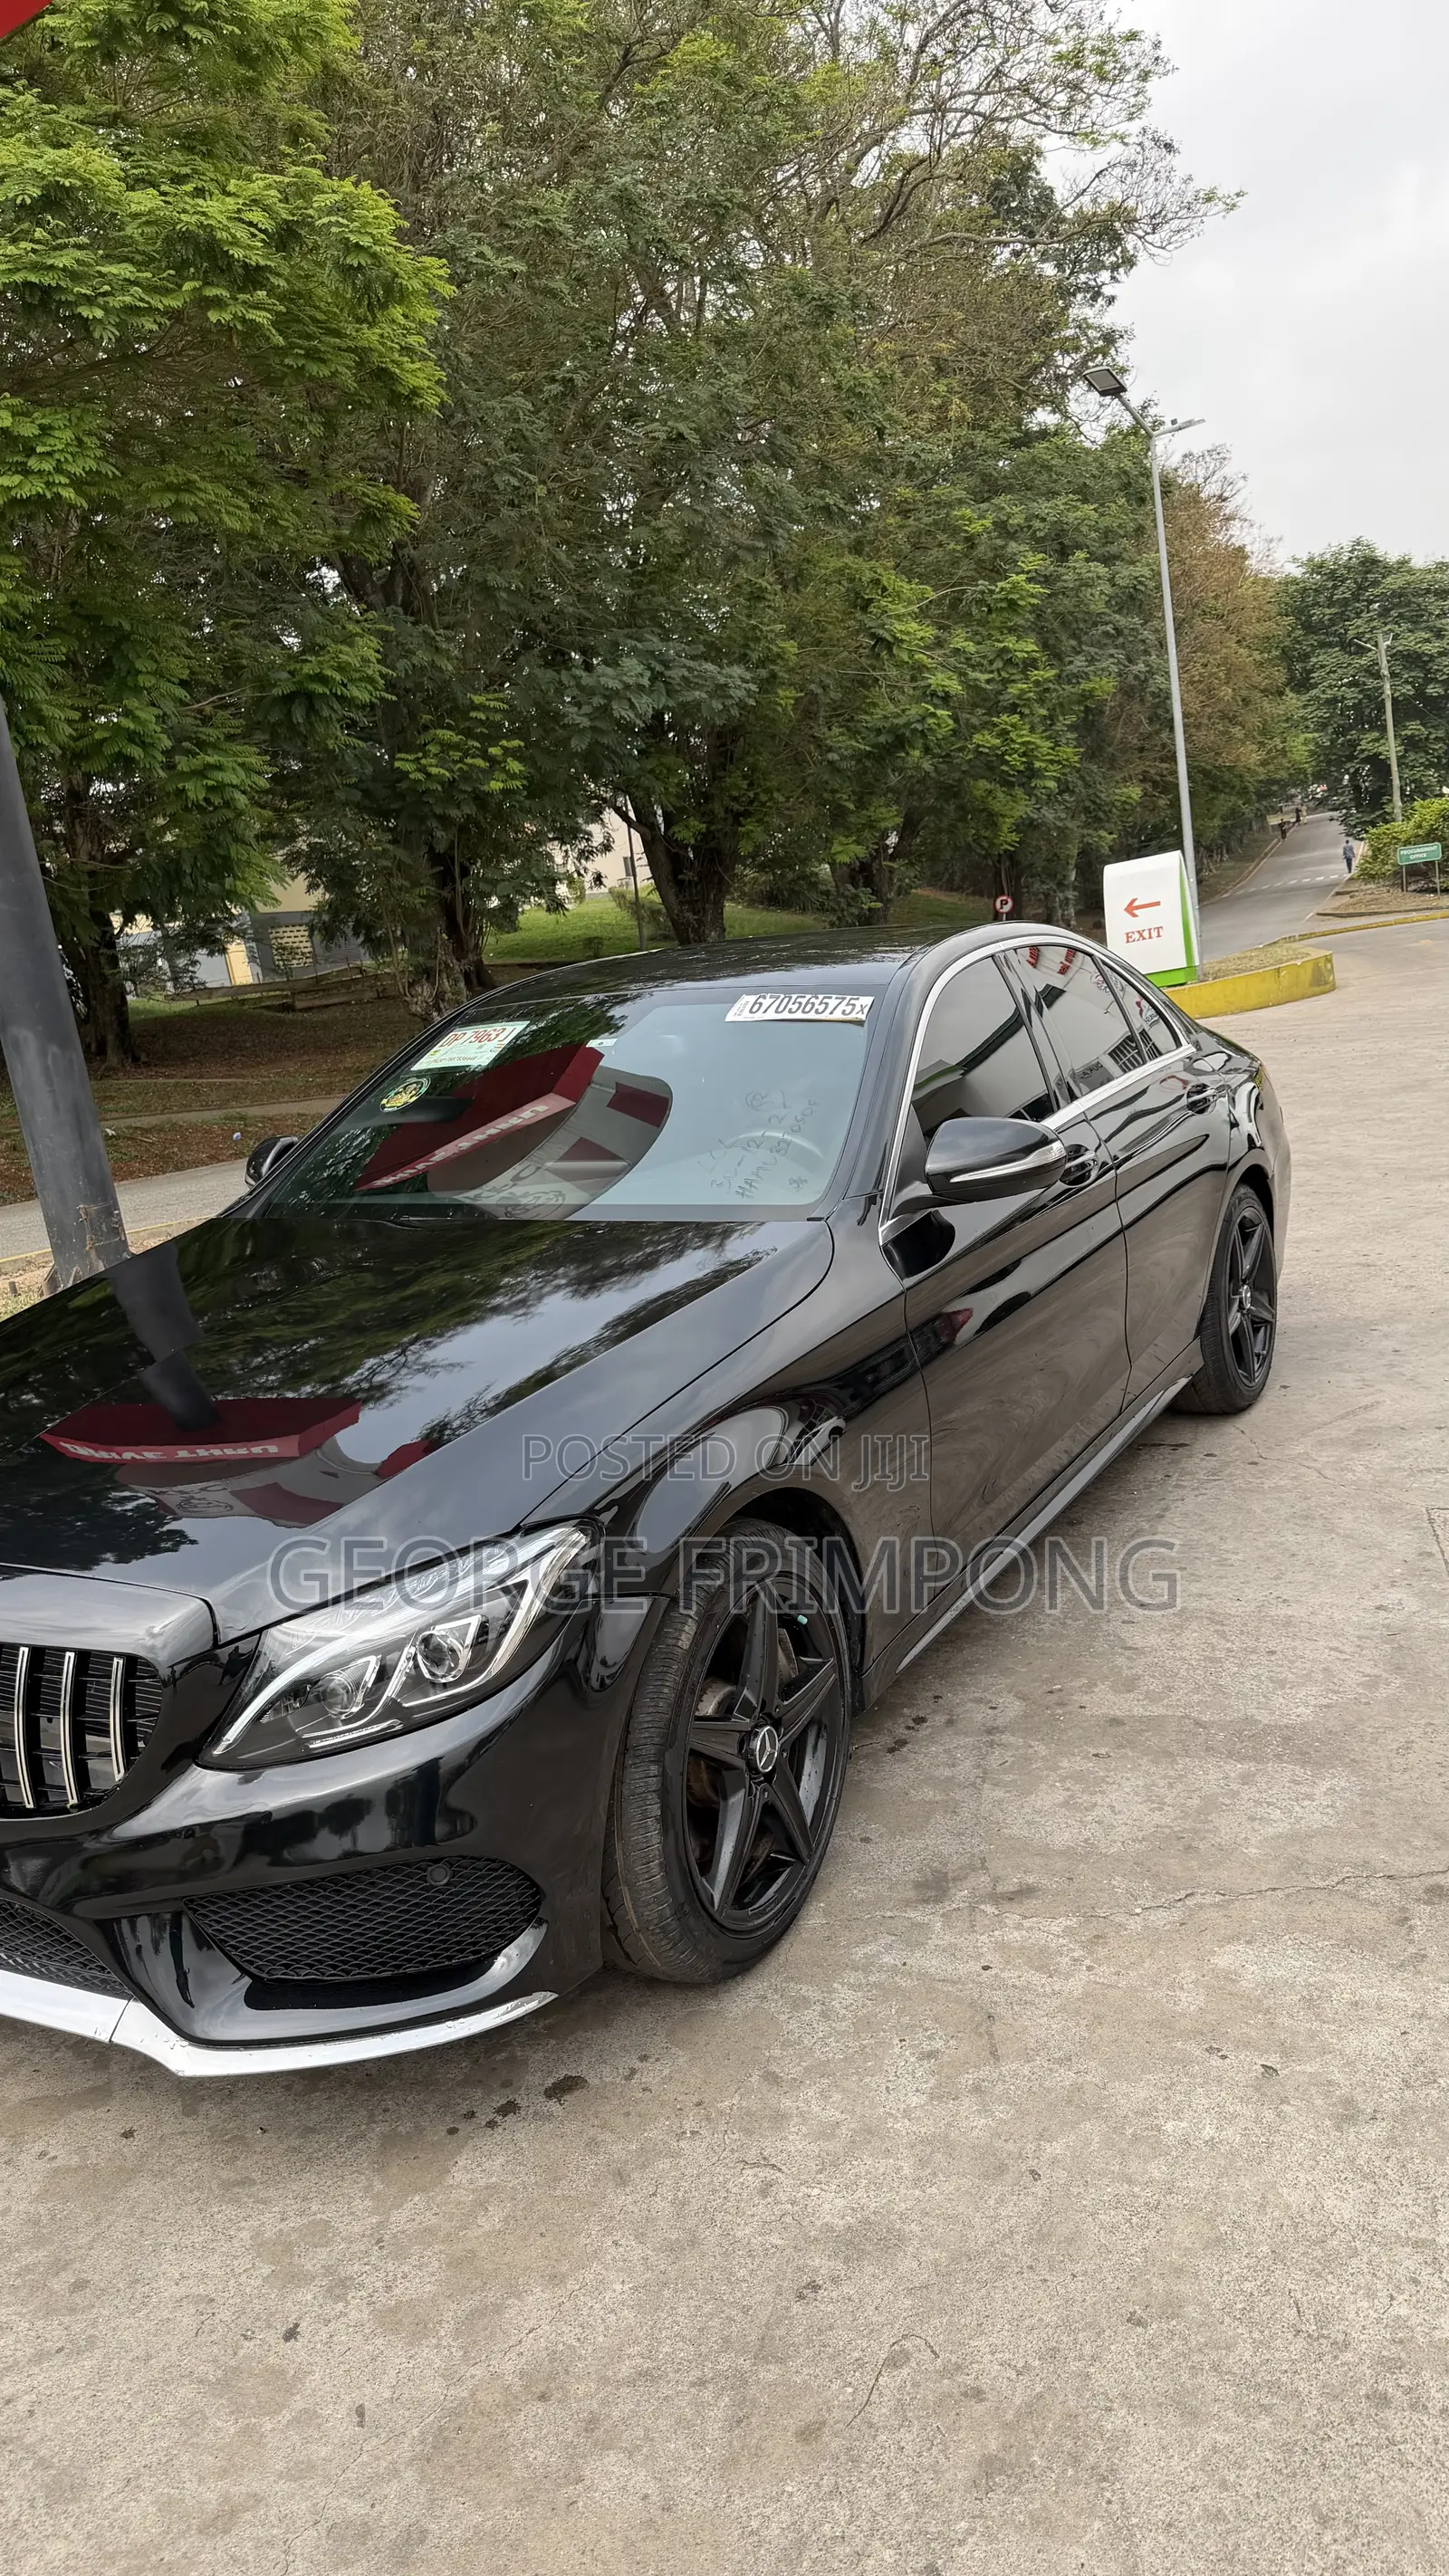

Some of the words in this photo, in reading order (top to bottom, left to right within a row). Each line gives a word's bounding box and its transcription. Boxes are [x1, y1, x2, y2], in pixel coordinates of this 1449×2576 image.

[999, 899, 1009, 910] P
[1124, 926, 1164, 943] EXIT
[441, 1030, 463, 1048] DP
[465, 1028, 507, 1044] 7963
